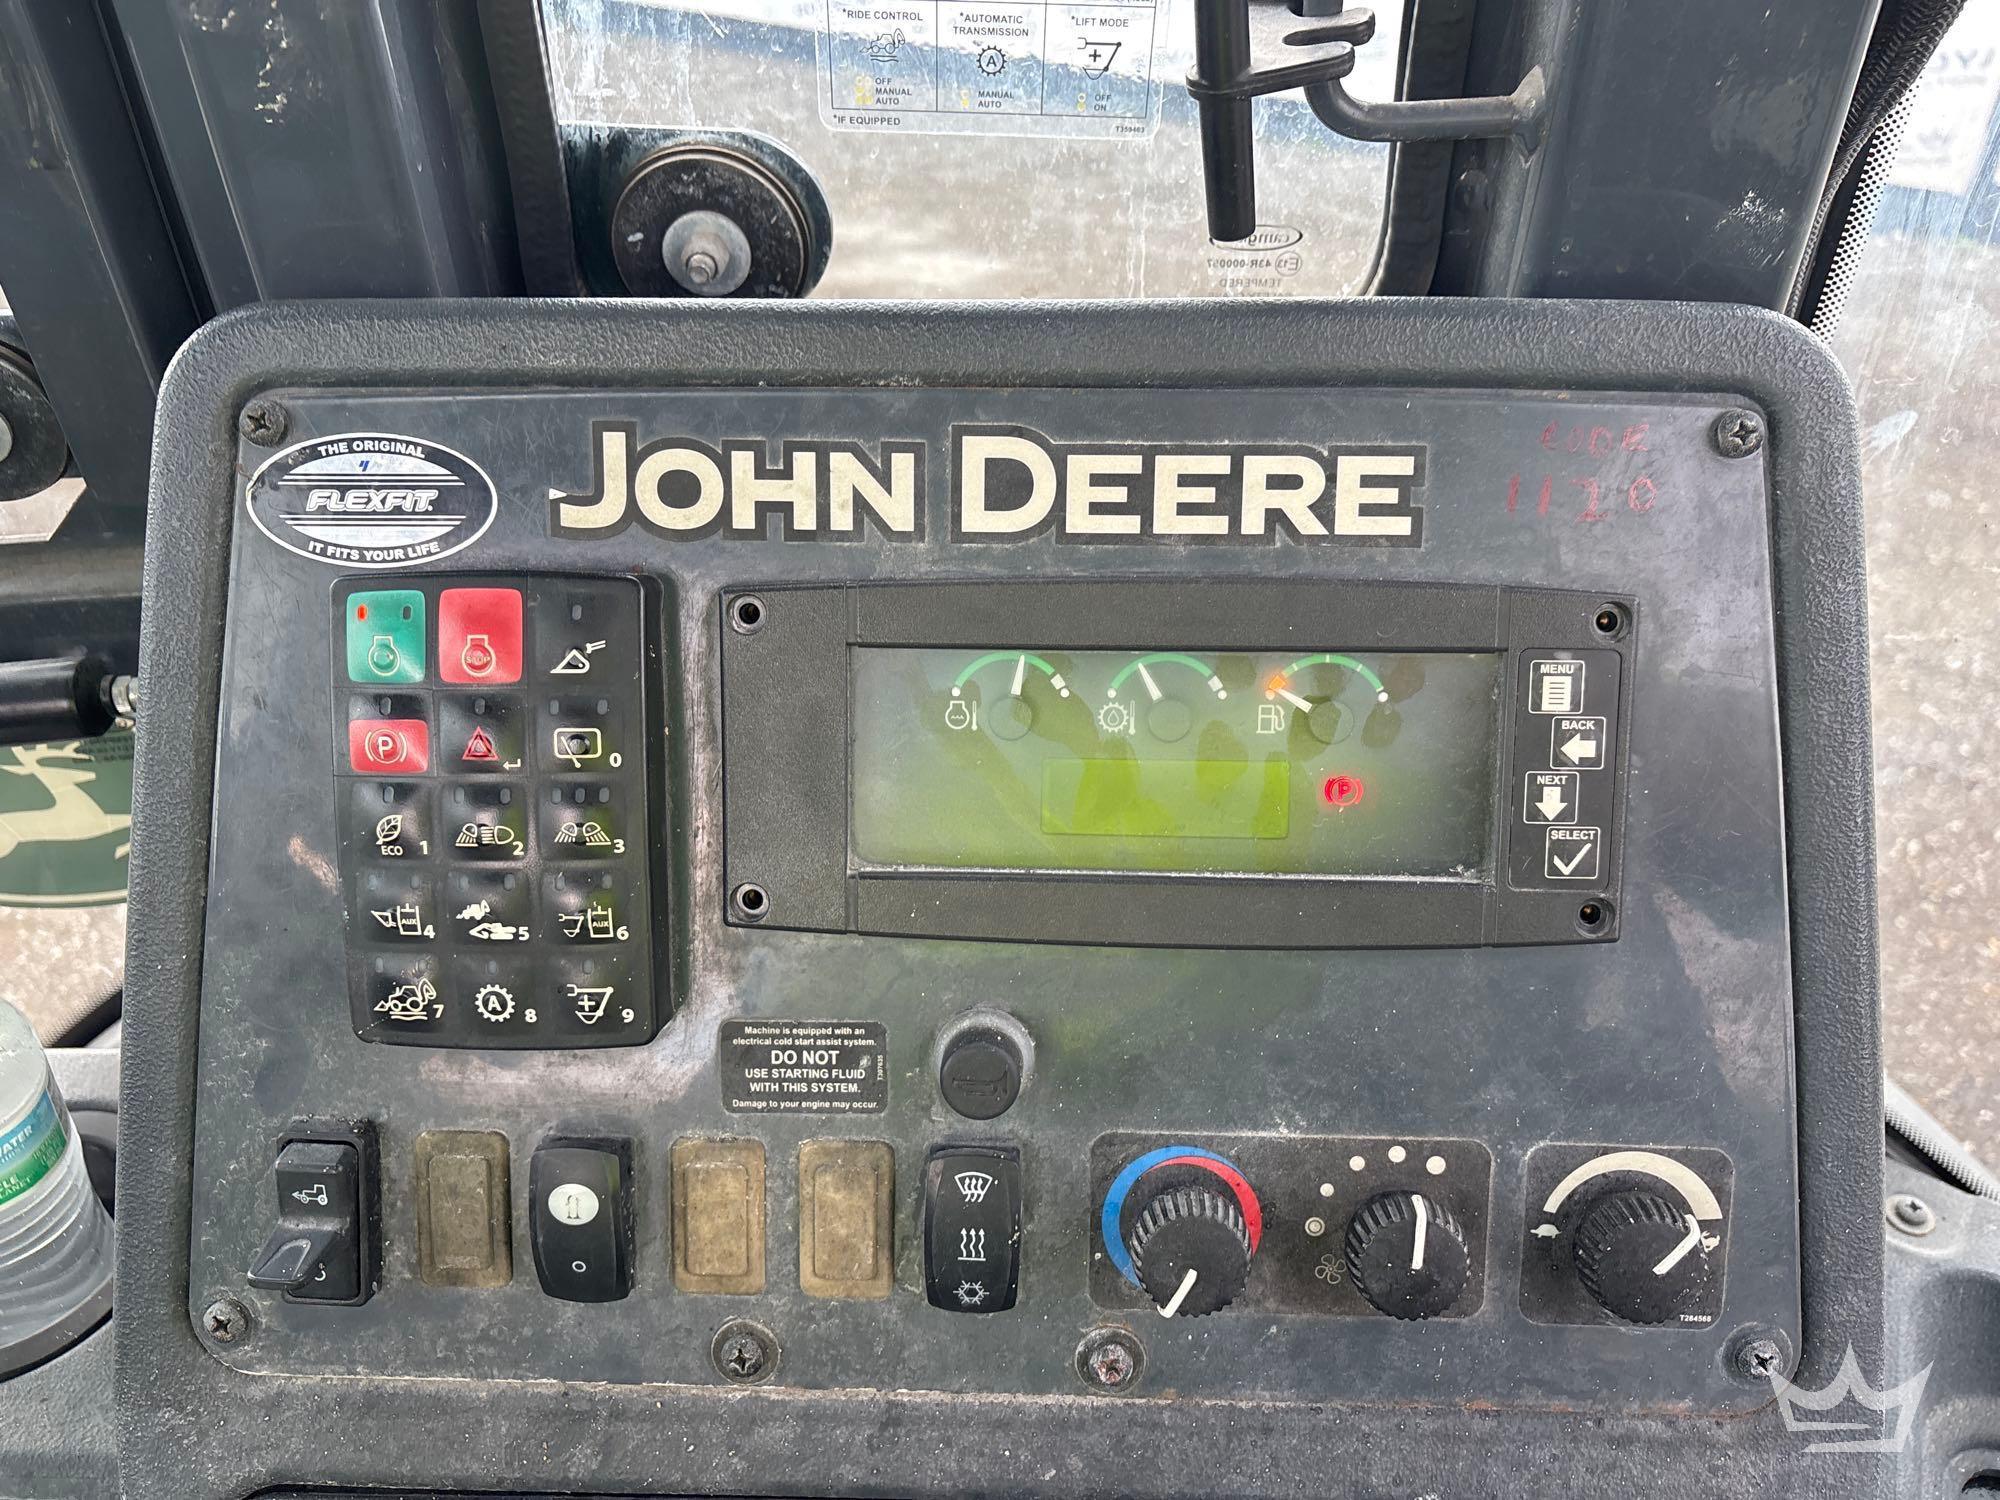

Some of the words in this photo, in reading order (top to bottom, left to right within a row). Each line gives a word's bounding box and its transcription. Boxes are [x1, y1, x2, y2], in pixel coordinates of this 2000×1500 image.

[874, 11, 923, 21] CONTROL
[1099, 18, 1129, 28] MODE
[953, 26, 1029, 37] TRANSMISSION
[875, 77, 892, 85] OFF
[875, 87, 912, 96] MANUAL
[978, 91, 1014, 99] MANUAL
[875, 97, 900, 106] AUTO
[1094, 94, 1112, 102] OFF
[978, 100, 1002, 108] AUTO
[1093, 104, 1107, 112] ON
[849, 116, 901, 126] EQUIPPED
[317, 441, 349, 457] THE
[352, 440, 426, 458] ORIGINAL
[559, 431, 915, 532] JOHN
[961, 435, 1415, 535] DEERE
[307, 541, 324, 553] IT
[327, 544, 360, 561] FITS
[362, 548, 404, 562] YOUR
[407, 541, 441, 556] LIFE
[1540, 664, 1574, 674] MENU
[1561, 720, 1595, 730] BACK
[609, 752, 622, 767] 0
[1536, 775, 1568, 785] NEXT
[1550, 830, 1595, 840] SELECT
[381, 845, 403, 856] ECO
[419, 840, 429, 855] 1
[512, 841, 524, 856] 2
[613, 839, 625, 854] 3
[401, 917, 417, 925] AUX
[592, 920, 609, 928] AUX
[423, 925, 435, 939] 4
[518, 926, 530, 941] 5
[616, 926, 629, 941] 6
[433, 1004, 444, 1018] 7
[524, 1008, 537, 1023] 8
[621, 1008, 634, 1023] 9
[744, 1026, 780, 1035] Machine
[782, 1027, 791, 1035] is
[792, 1027, 832, 1038] equipped
[834, 1026, 852, 1035] with
[732, 1037, 772, 1046] electrical
[773, 1038, 792, 1046] cold
[794, 1038, 814, 1046] start
[816, 1038, 842, 1046] assist
[843, 1038, 877, 1048] system.
[771, 1050, 797, 1065] DO
[802, 1050, 840, 1065] NOT
[745, 1068, 769, 1079] USE
[771, 1068, 829, 1079] STARTING
[832, 1068, 866, 1079] FLUID
[750, 1082, 779, 1093] WITH
[782, 1082, 808, 1093] THIS
[810, 1082, 861, 1093] SYSTEM.
[732, 1099, 768, 1109] Damage
[769, 1100, 778, 1108] to
[780, 1101, 799, 1110] your
[801, 1100, 831, 1110] engine
[832, 1101, 850, 1109] may
[852, 1101, 879, 1109] occur.
